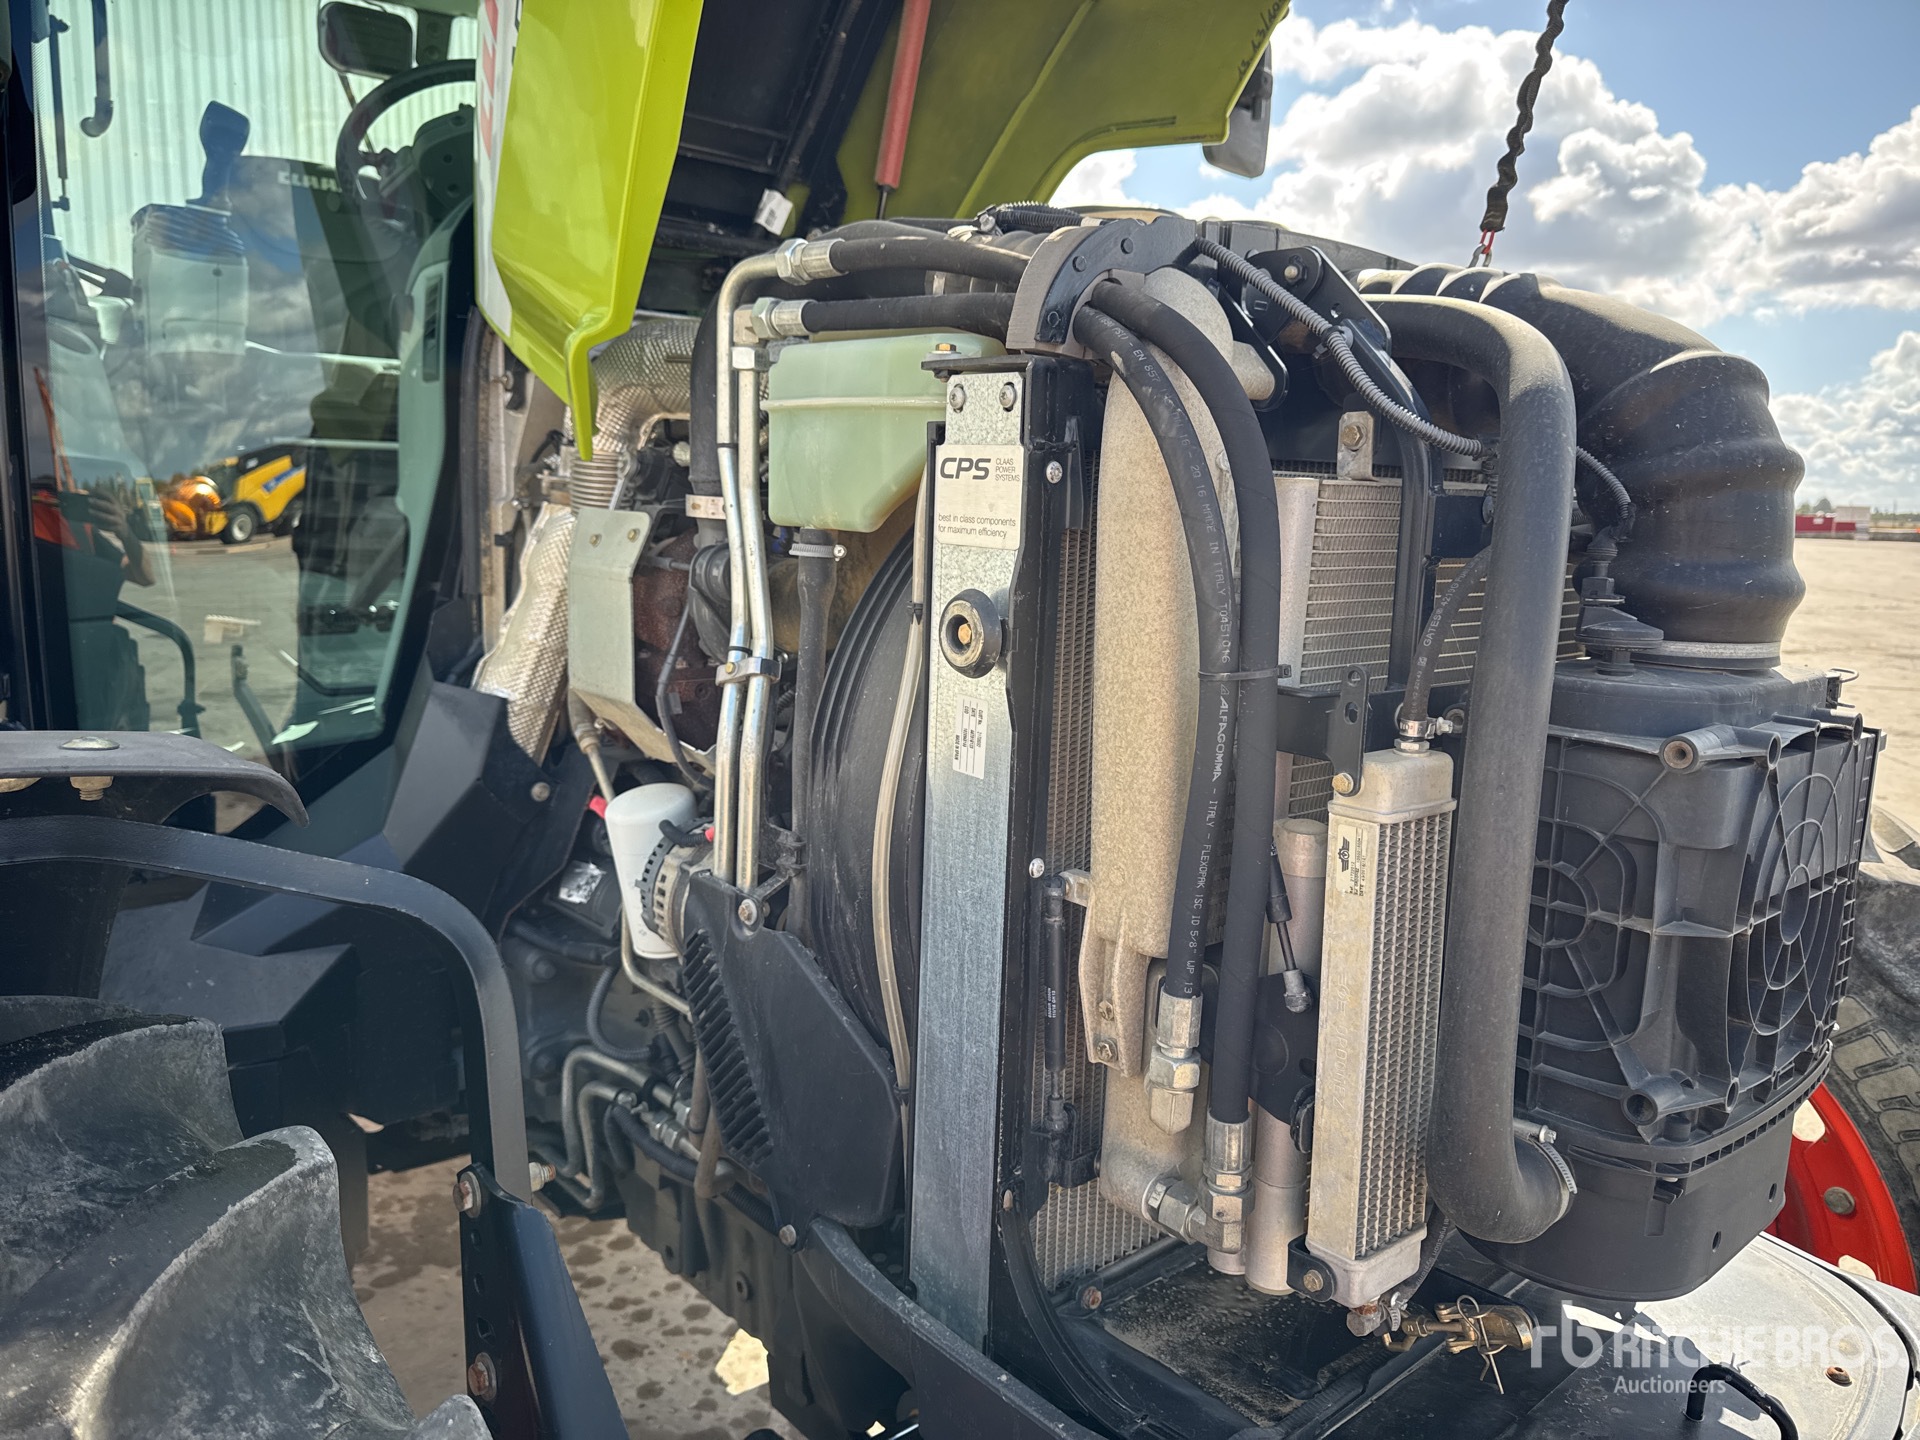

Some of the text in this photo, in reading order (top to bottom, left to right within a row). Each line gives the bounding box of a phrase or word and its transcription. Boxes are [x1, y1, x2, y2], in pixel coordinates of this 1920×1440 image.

[1133, 349, 1147, 361] EN
[1144, 364, 1160, 382] 857
[940, 457, 991, 480] CPS
[995, 458, 1014, 466] CLAAS
[995, 466, 1016, 474] POWER
[995, 474, 1020, 482] SYSTEMS
[1196, 484, 1207, 498] 16
[938, 513, 1016, 527] best in class components
[1202, 503, 1217, 533] MADE
[938, 524, 1007, 539] for maximum efficiency
[1209, 541, 1220, 555] IN
[1213, 562, 1226, 596] ITALY
[1212, 696, 1229, 782] ALFAGOMMA
[1206, 800, 1218, 828] ITALY
[1196, 844, 1211, 889] FLEXOPAK
[1191, 915, 1200, 926] ID
[1186, 960, 1195, 974] WP
[1184, 982, 1193, 994] 13
